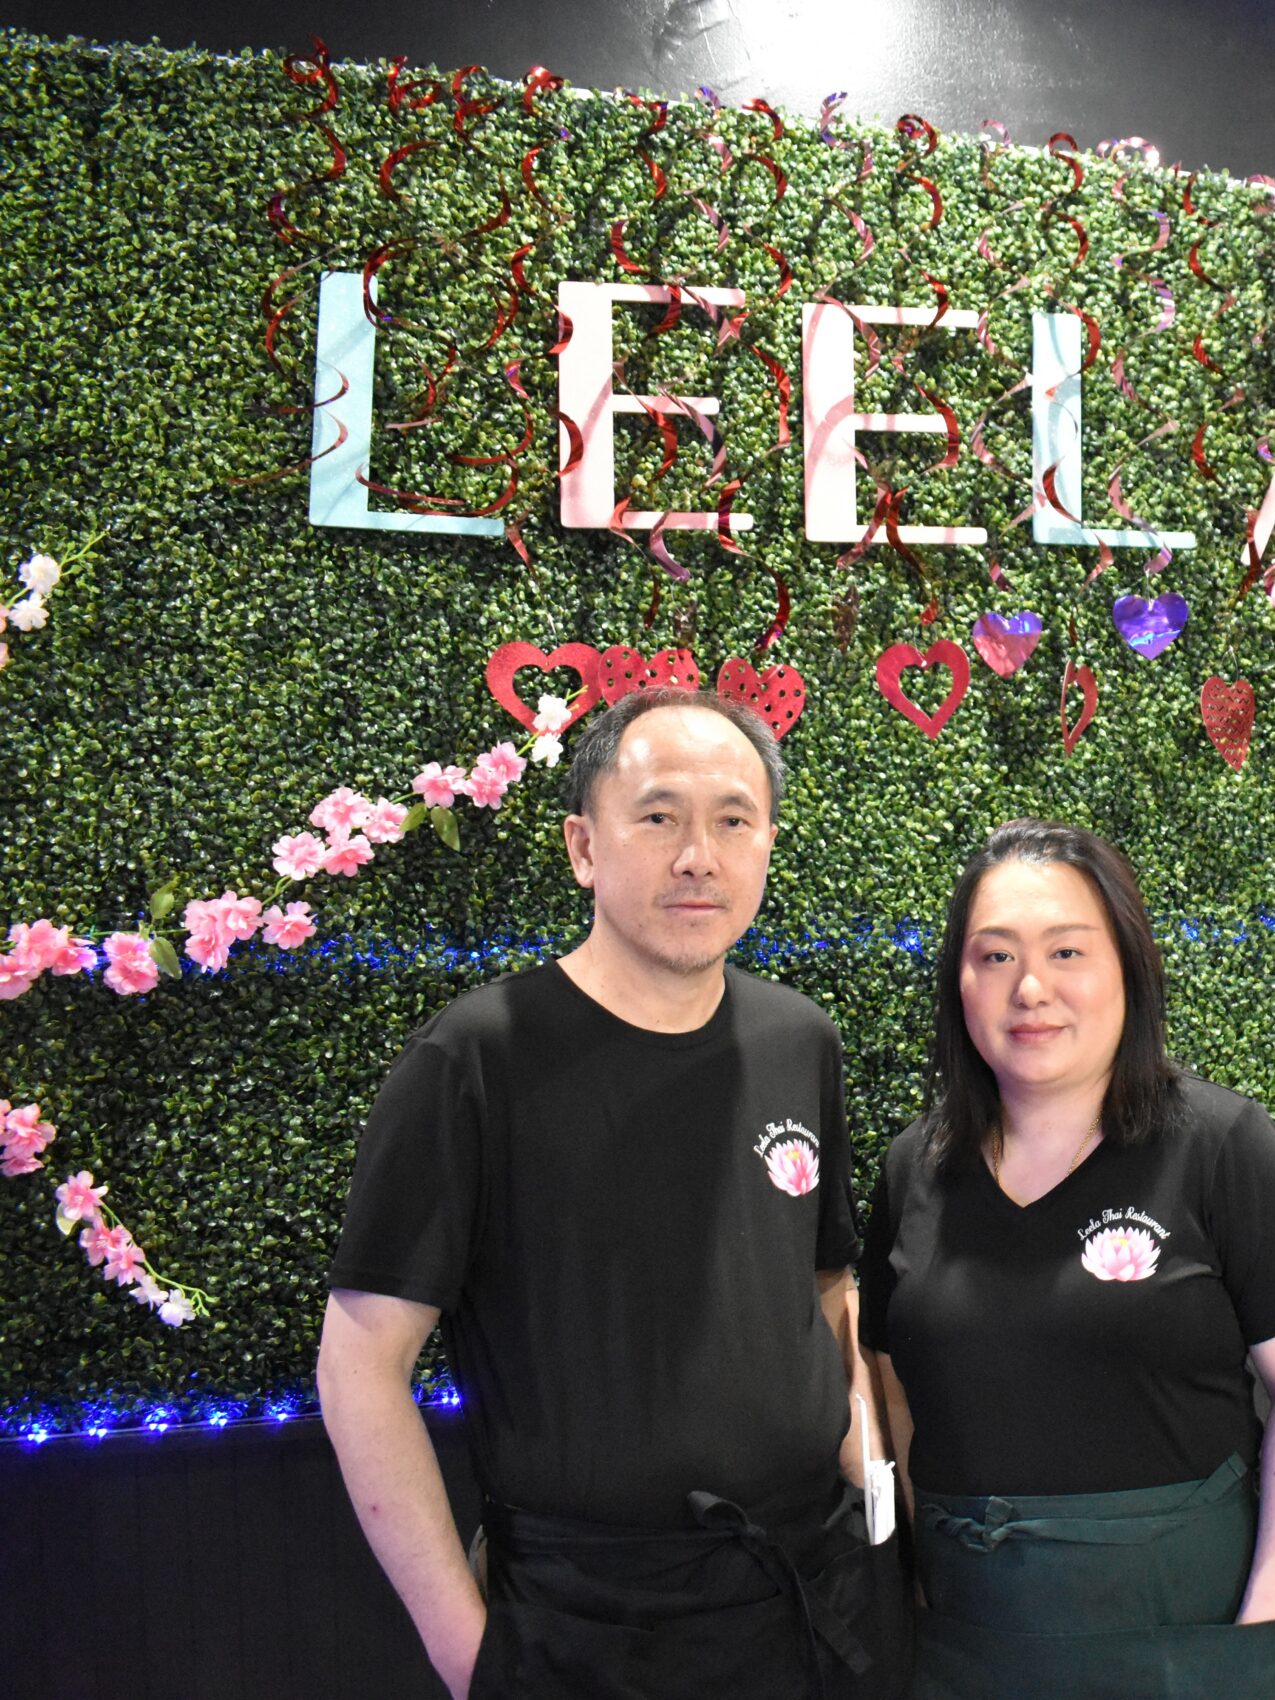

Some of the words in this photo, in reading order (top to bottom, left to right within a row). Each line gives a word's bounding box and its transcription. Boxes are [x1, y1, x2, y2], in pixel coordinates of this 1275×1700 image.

[1077, 1218, 1101, 1240] Leela
[1102, 1208, 1123, 1224] Thai
[1125, 1206, 1171, 1239] Restaurant
